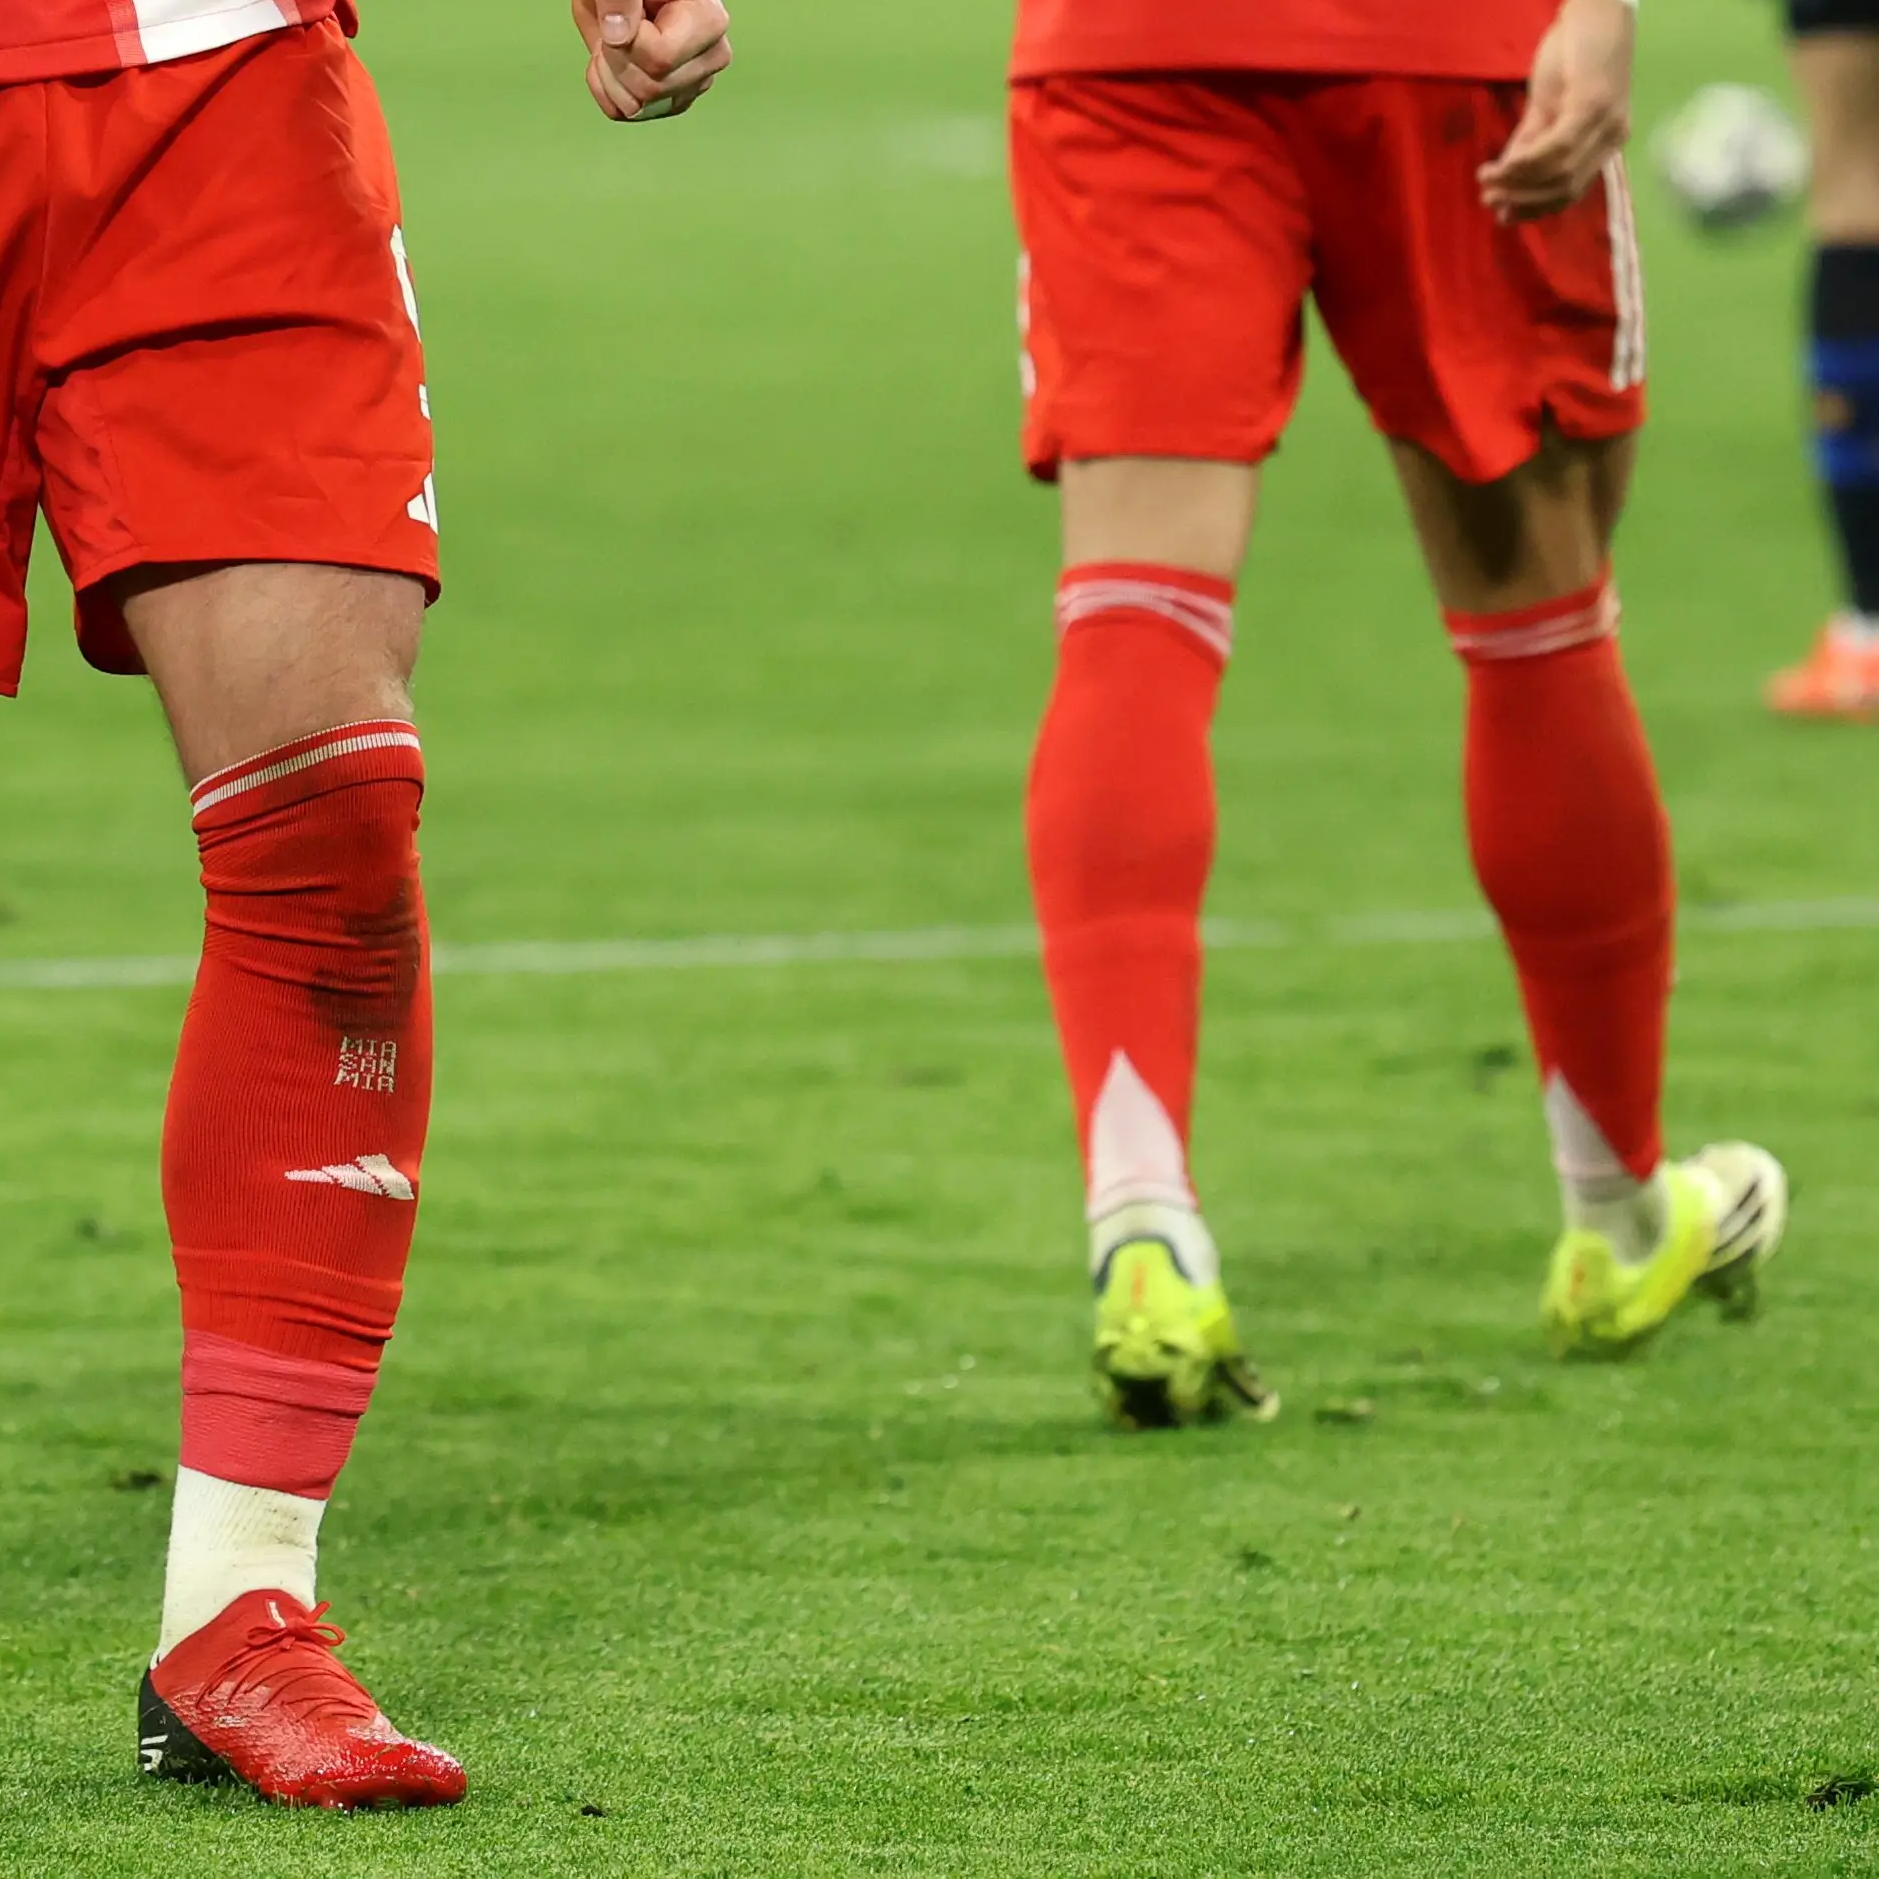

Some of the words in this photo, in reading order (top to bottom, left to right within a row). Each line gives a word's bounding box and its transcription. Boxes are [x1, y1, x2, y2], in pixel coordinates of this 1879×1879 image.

[340, 1036, 397, 1059] MIA
[338, 1052, 395, 1077] SAN
[333, 1068, 394, 1093] MIA
